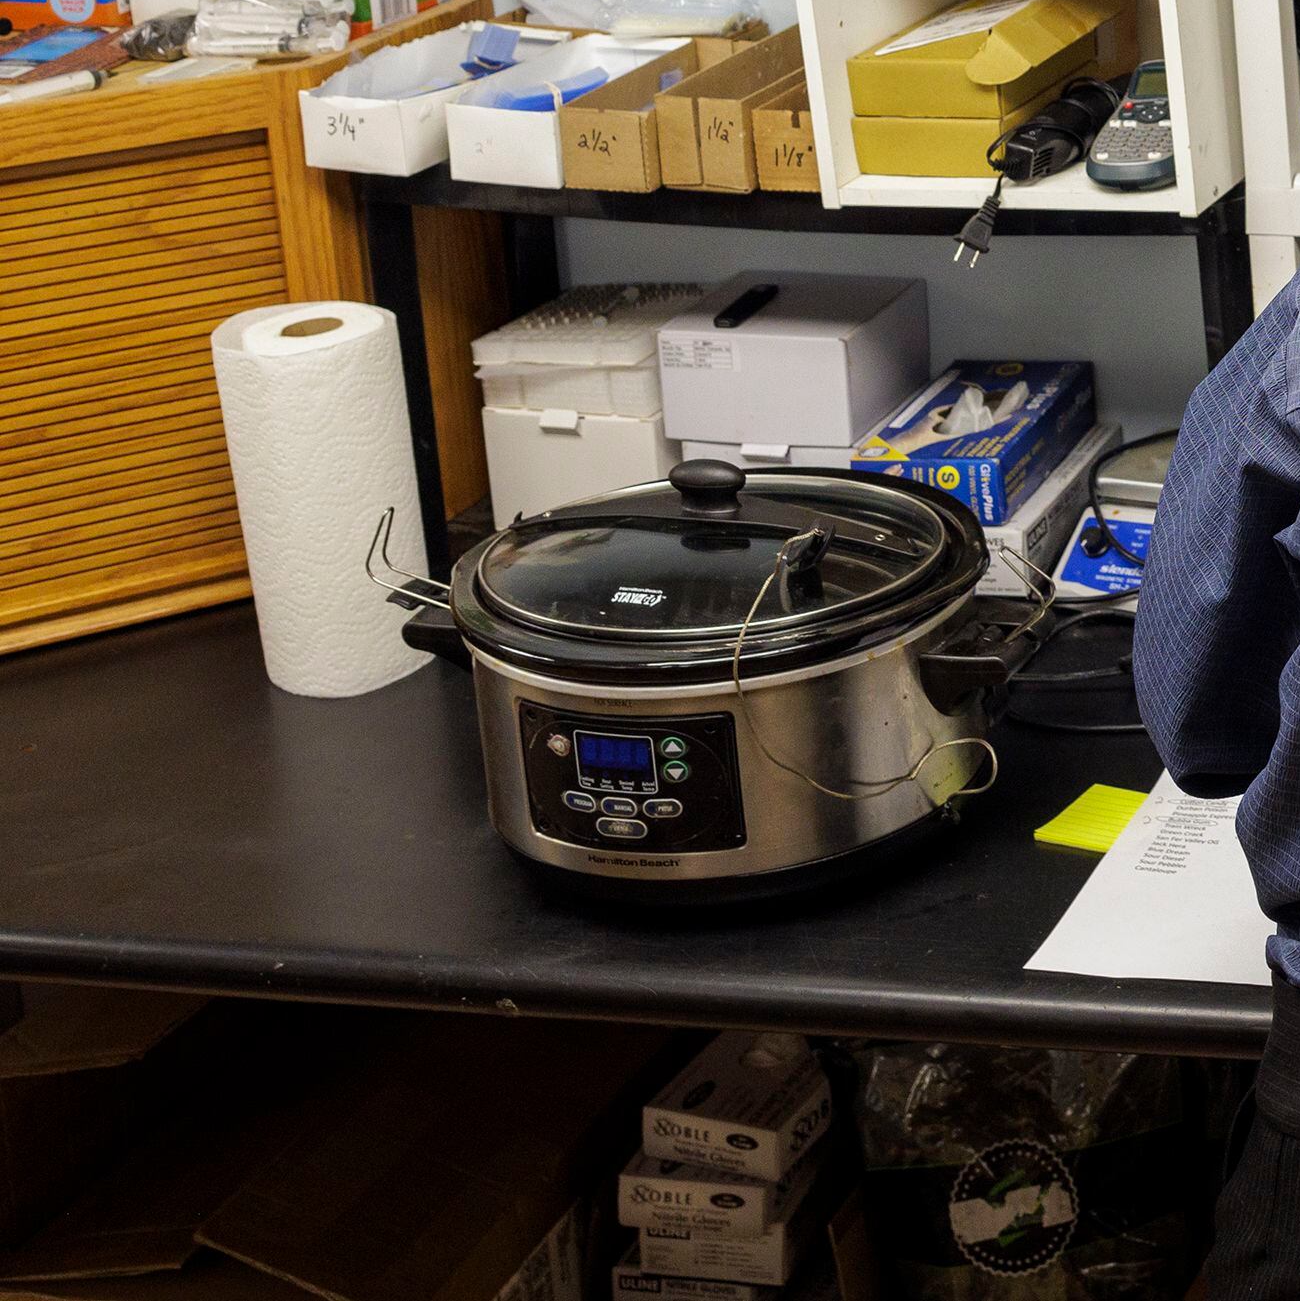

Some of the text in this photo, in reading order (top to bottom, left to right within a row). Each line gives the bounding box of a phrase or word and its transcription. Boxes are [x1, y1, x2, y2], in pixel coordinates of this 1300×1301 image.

[979, 464, 994, 522] GlovePlus
[588, 854, 680, 868] Hamilton Beach
[620, 1276, 662, 1292] ULINE
